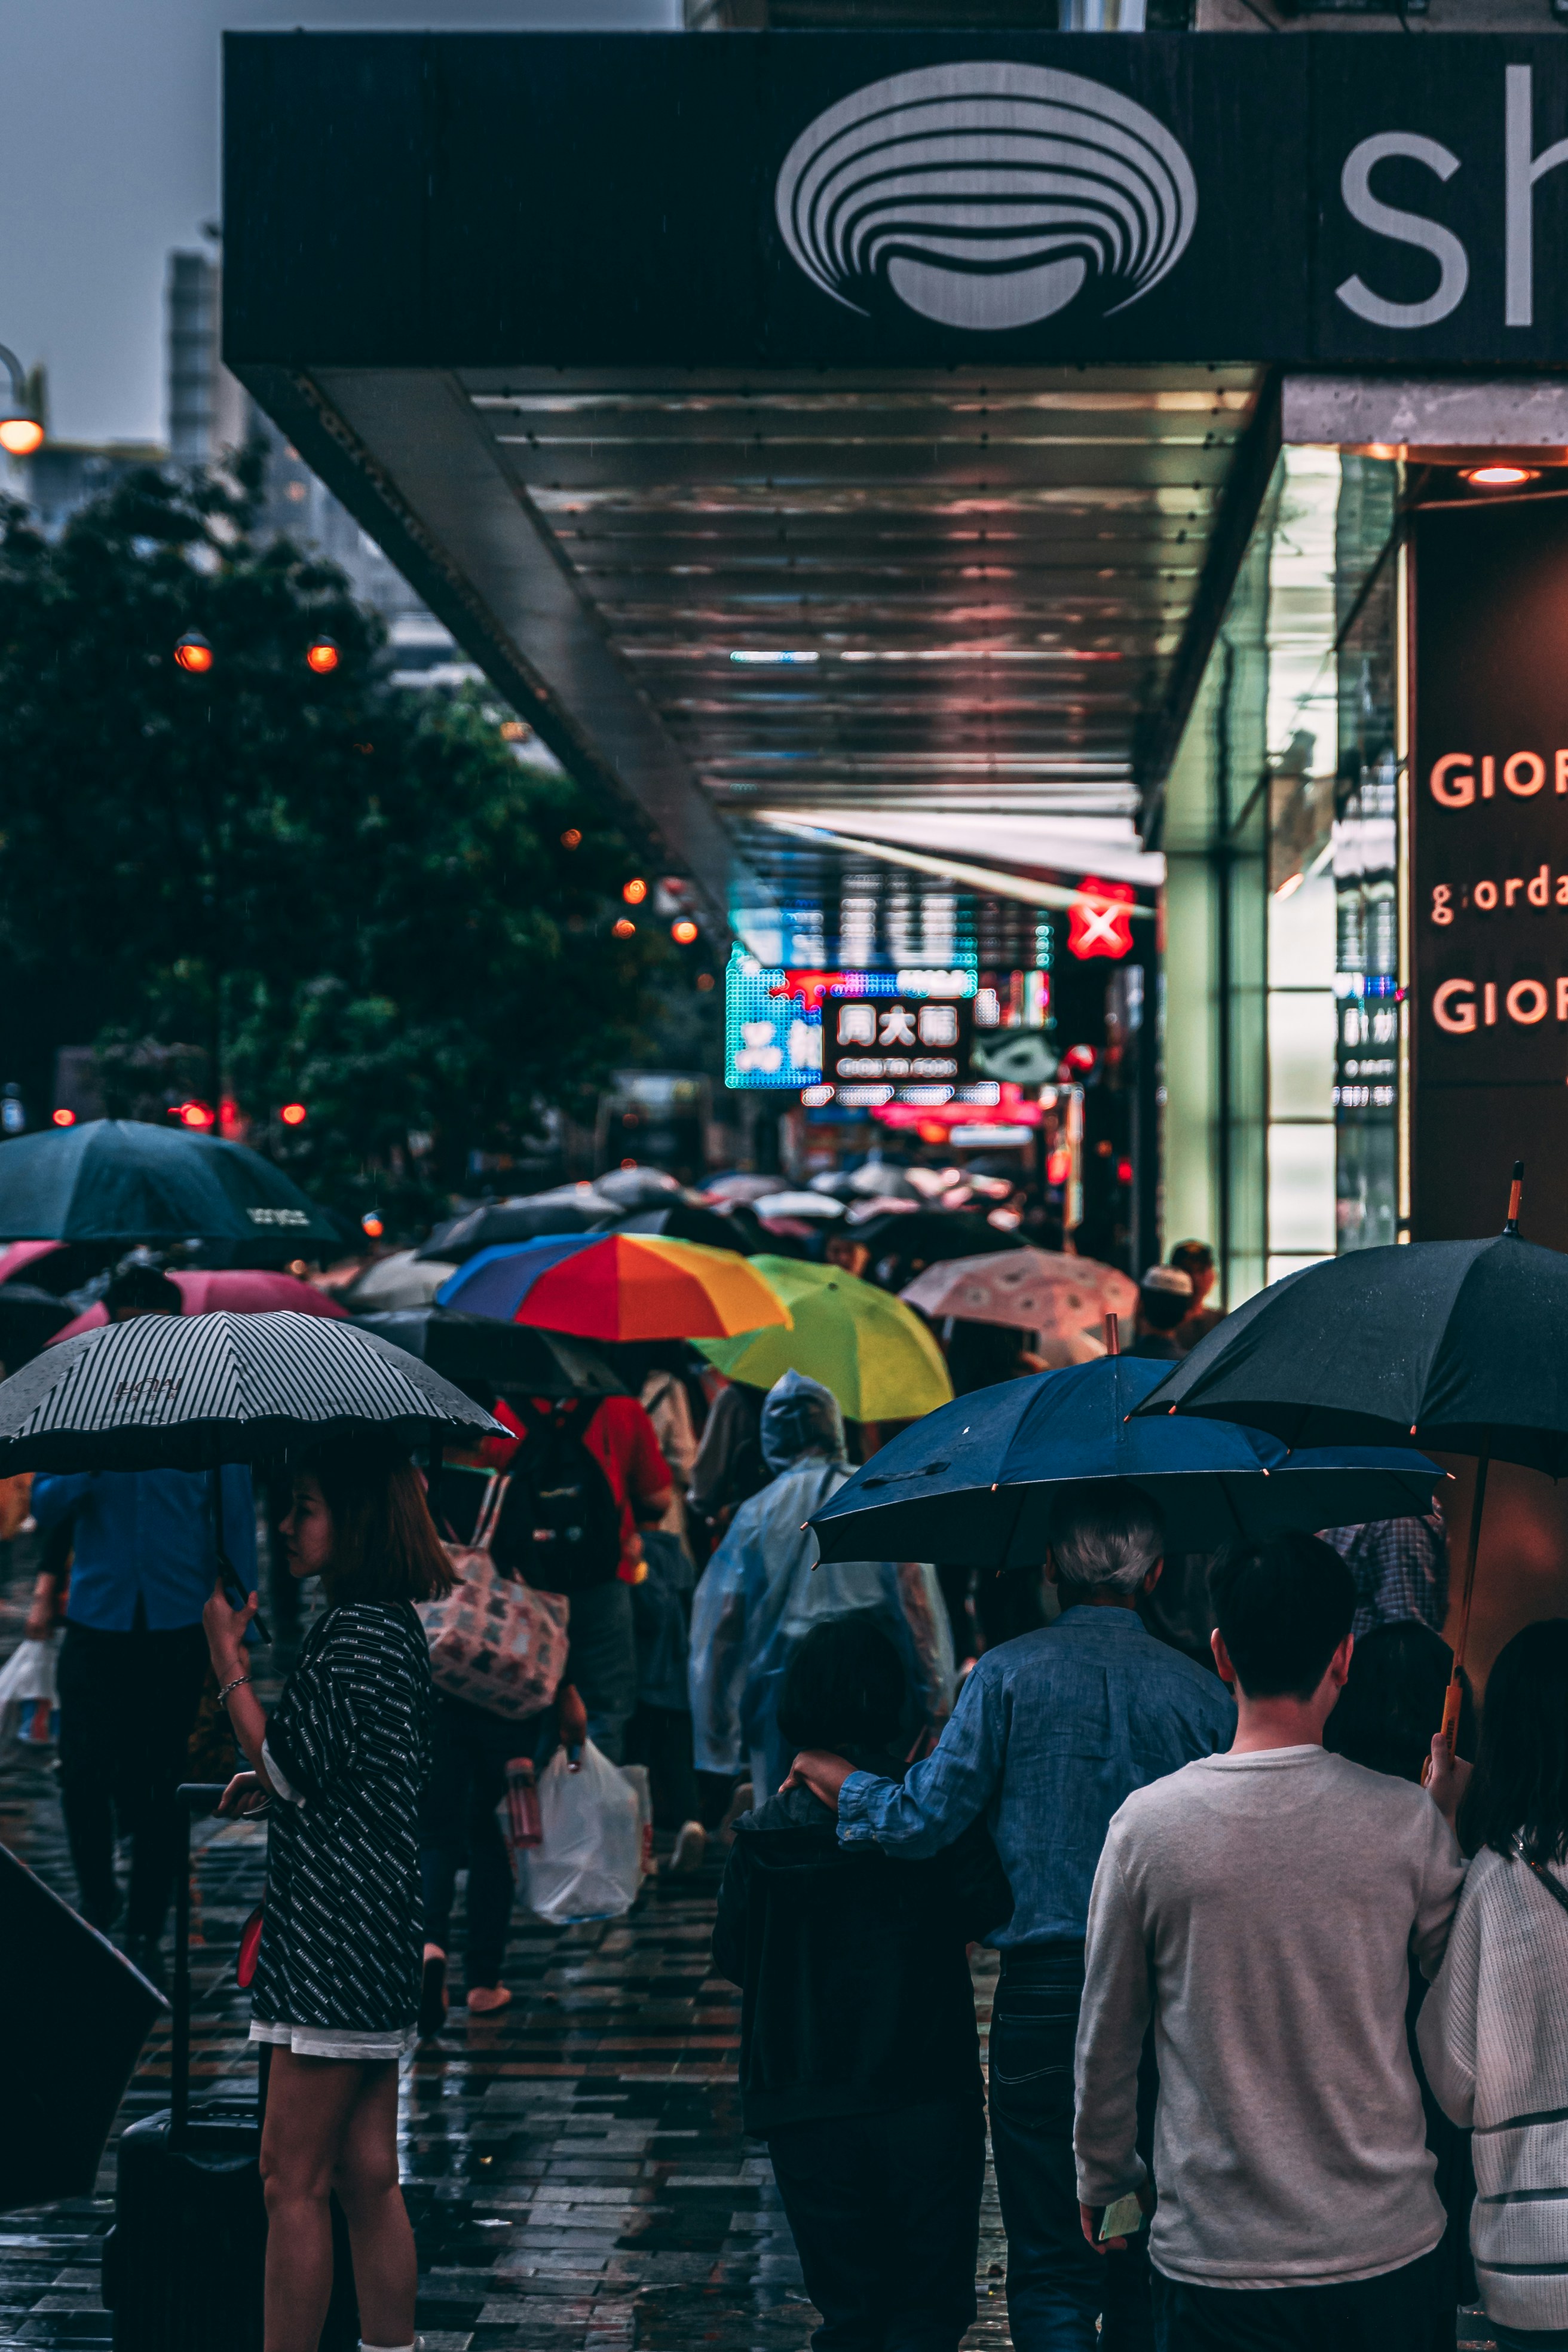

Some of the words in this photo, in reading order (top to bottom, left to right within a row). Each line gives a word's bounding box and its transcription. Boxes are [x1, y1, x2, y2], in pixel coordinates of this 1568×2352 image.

[385, 1697, 411, 1714] BALENCIAGA
[300, 1727, 316, 1756] BALENCIAGA
[361, 1791, 384, 1817] BALENCIAGA
[296, 1835, 316, 1858] BALENCIAGA
[384, 1851, 408, 1875] BALENCIAGA
[302, 1865, 324, 1889] BALENCIAGA
[369, 1869, 393, 1895] BALENCIAGA
[310, 1896, 333, 1919] BALENCIAGA
[350, 1889, 373, 1915] BALENCIAGA
[359, 1922, 379, 1946] BALENCIAGA
[296, 1949, 320, 1974] BALENCIAGA
[342, 1941, 364, 1968] BALENCIAGA
[305, 1979, 329, 2004] BALENCIAGA
[350, 1974, 370, 1999] BALENCIAGA
